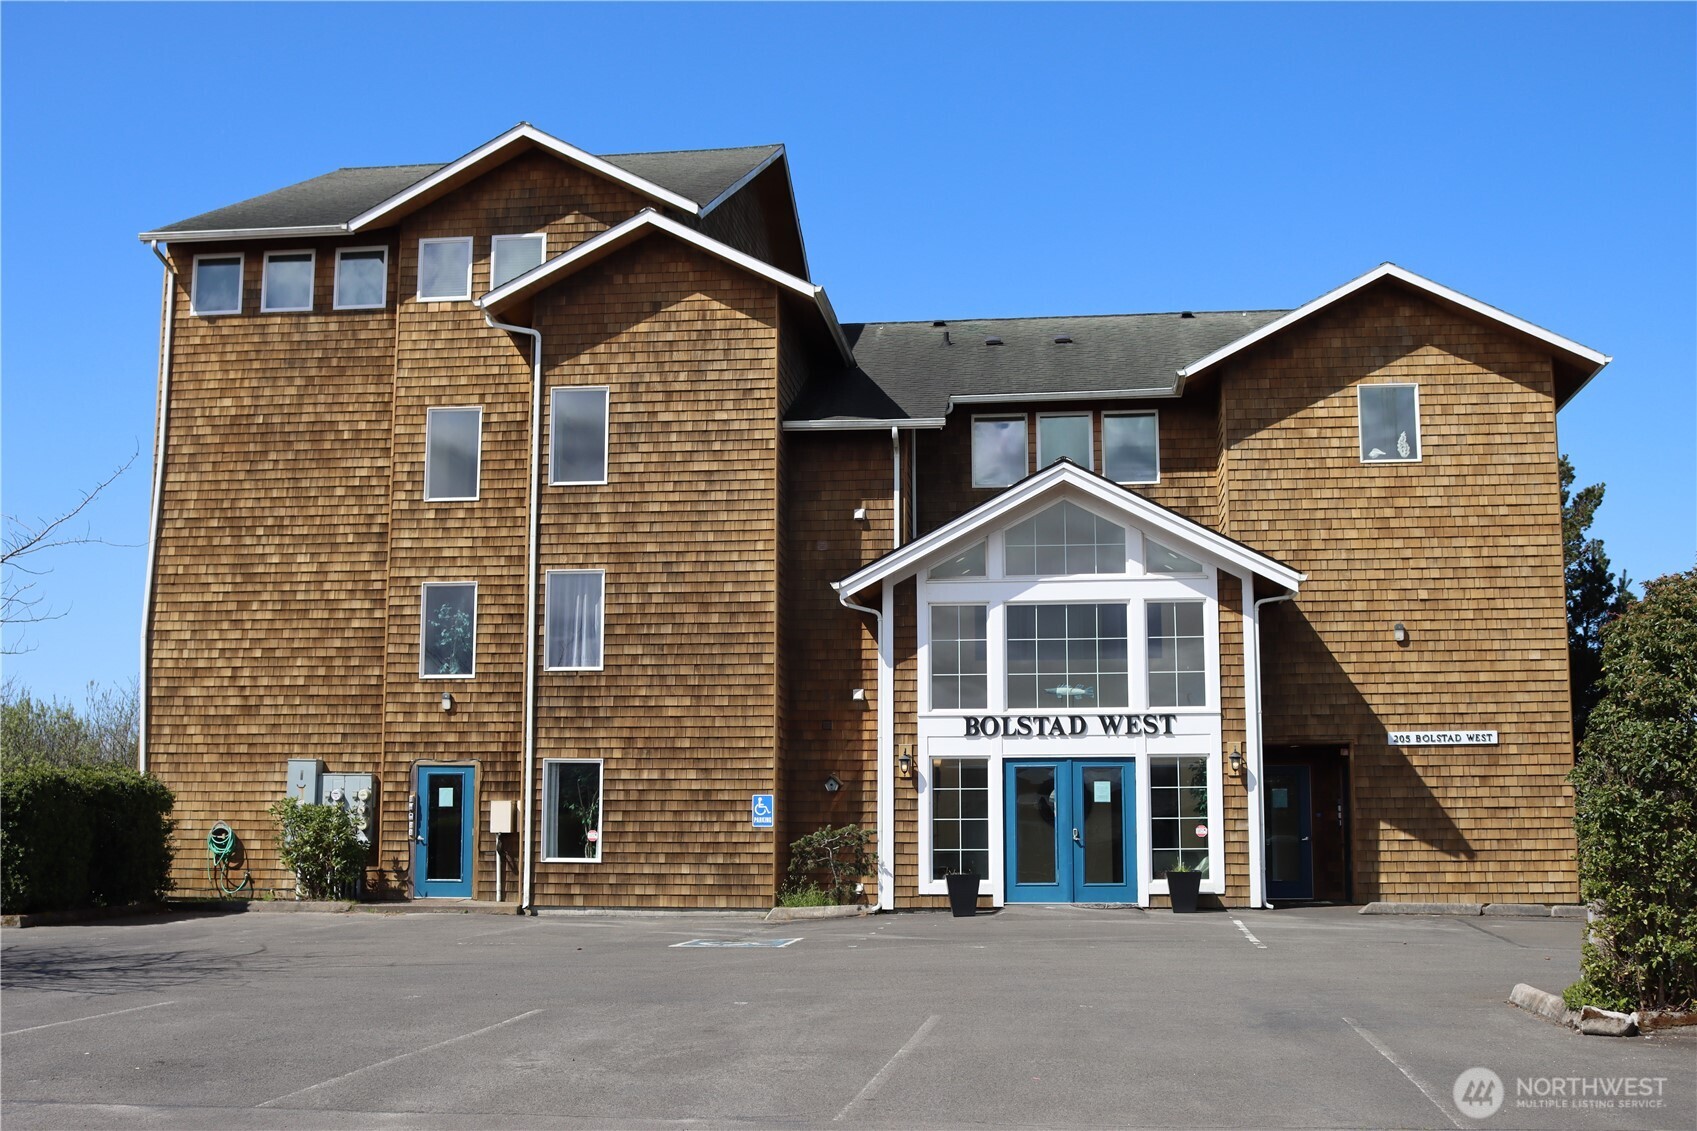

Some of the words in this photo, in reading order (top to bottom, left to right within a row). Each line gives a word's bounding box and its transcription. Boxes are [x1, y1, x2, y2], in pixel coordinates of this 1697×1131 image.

[963, 715, 1087, 737] BOLSTAD
[1098, 714, 1177, 736] WEST
[1393, 734, 1411, 743] 205
[1415, 733, 1462, 743] BOLSTAD
[1466, 733, 1493, 742] WEST
